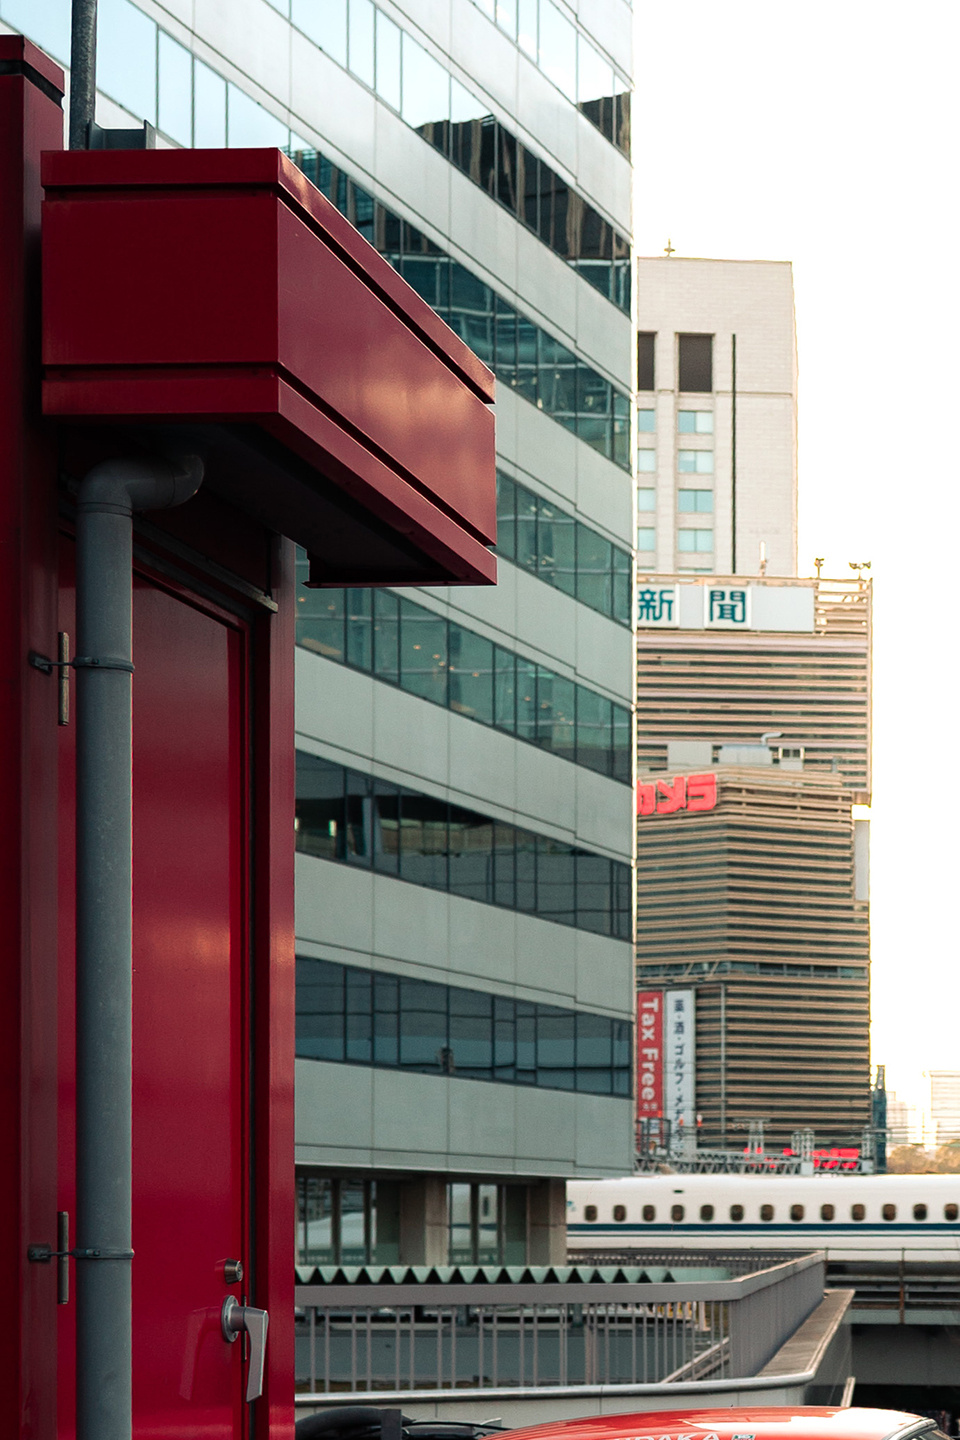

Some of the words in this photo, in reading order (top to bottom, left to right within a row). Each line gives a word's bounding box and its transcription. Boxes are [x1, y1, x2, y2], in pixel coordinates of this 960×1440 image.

[638, 590, 745, 622] 新聞
[641, 998, 658, 1041] Tax
[641, 1048, 658, 1100] Free
